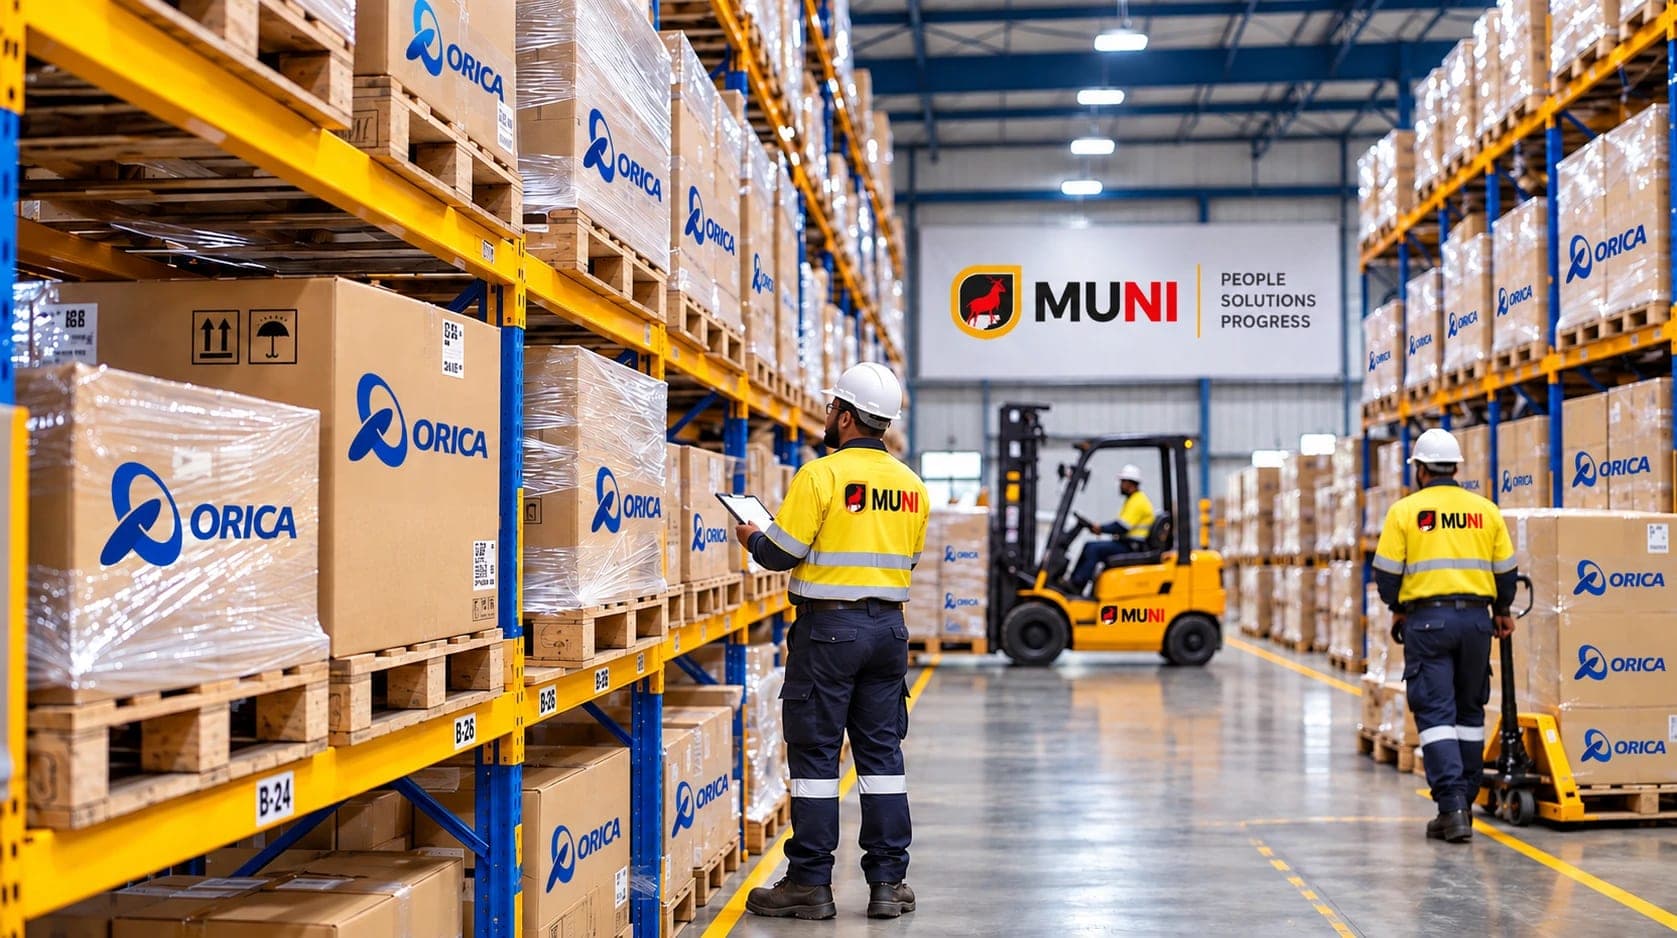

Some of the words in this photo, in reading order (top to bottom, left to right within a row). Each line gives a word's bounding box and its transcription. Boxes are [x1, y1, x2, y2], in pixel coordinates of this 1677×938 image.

[446, 44, 504, 101] ORICA
[617, 153, 662, 202] ORICA
[705, 218, 735, 255] ORICA
[1595, 224, 1647, 261] ORICA
[1221, 272, 1286, 286] PEOPLE
[1035, 281, 1178, 322] MUNI
[1221, 294, 1316, 308] SOLUTIONS
[1509, 285, 1533, 306] ORICA
[1221, 315, 1311, 329] PROGRESS
[1457, 311, 1478, 331] ORICA
[412, 419, 488, 459] ORICA
[1599, 456, 1650, 477] ORICA
[623, 495, 661, 519] ORICA
[872, 488, 919, 513] MUNI
[190, 502, 298, 541] ORICA
[1441, 513, 1483, 529] MUNI
[706, 527, 727, 543] ORICA
[1609, 572, 1665, 588] ORICA
[1121, 608, 1164, 623] MUNI
[1610, 657, 1665, 672] ORICA
[540, 688, 555, 713] B-26
[455, 717, 475, 744] B-26
[1614, 740, 1666, 754] ORICA
[259, 778, 291, 817] B-24
[696, 774, 728, 809] ORICA
[578, 817, 621, 860] ORICA
